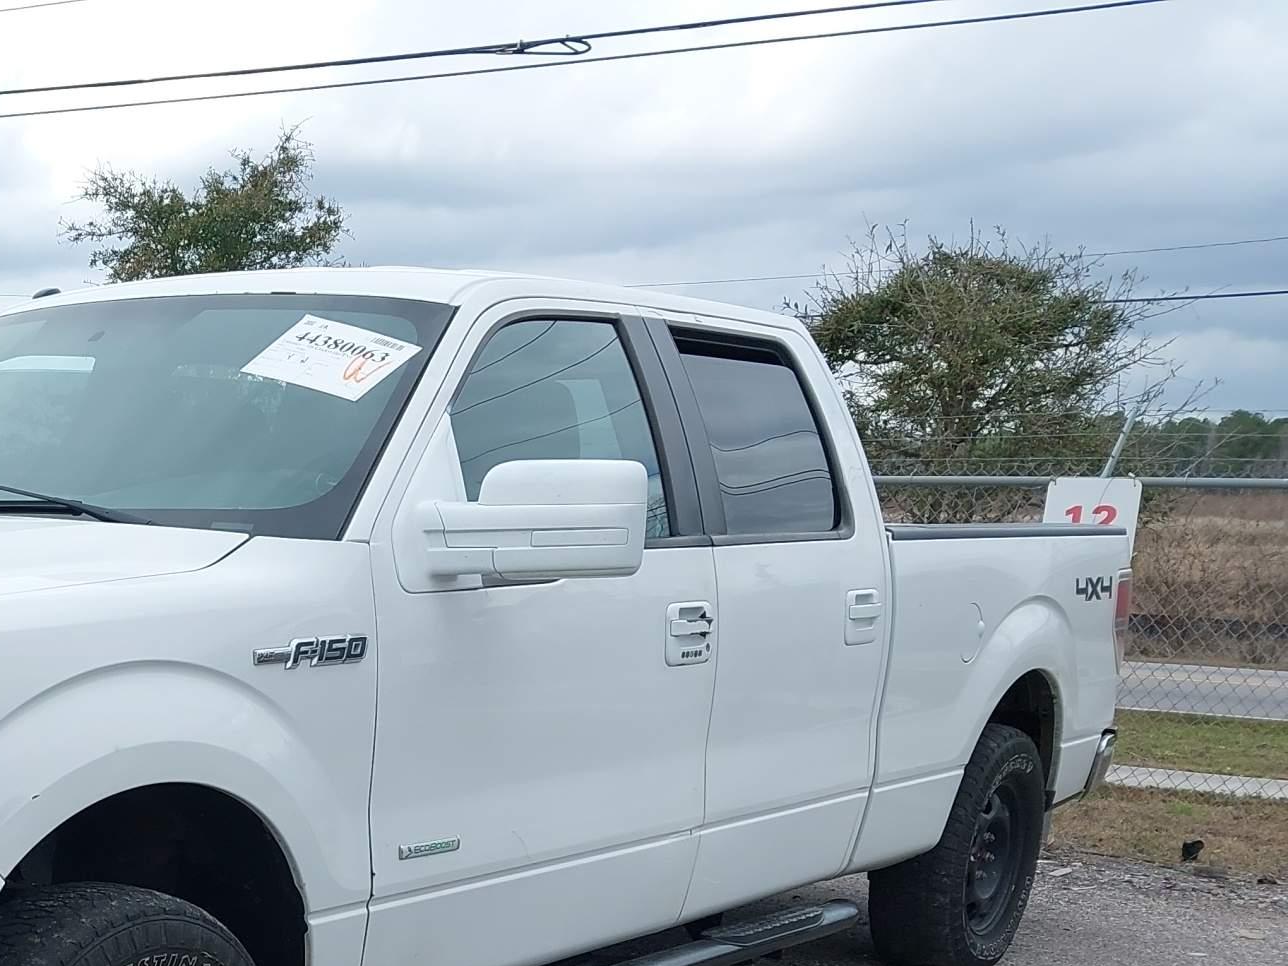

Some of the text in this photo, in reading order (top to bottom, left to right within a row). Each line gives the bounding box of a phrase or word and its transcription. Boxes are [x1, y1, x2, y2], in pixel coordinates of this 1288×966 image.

[296, 331, 390, 363] 44380063
[1064, 505, 1118, 525] 12
[286, 636, 368, 668] F-150
